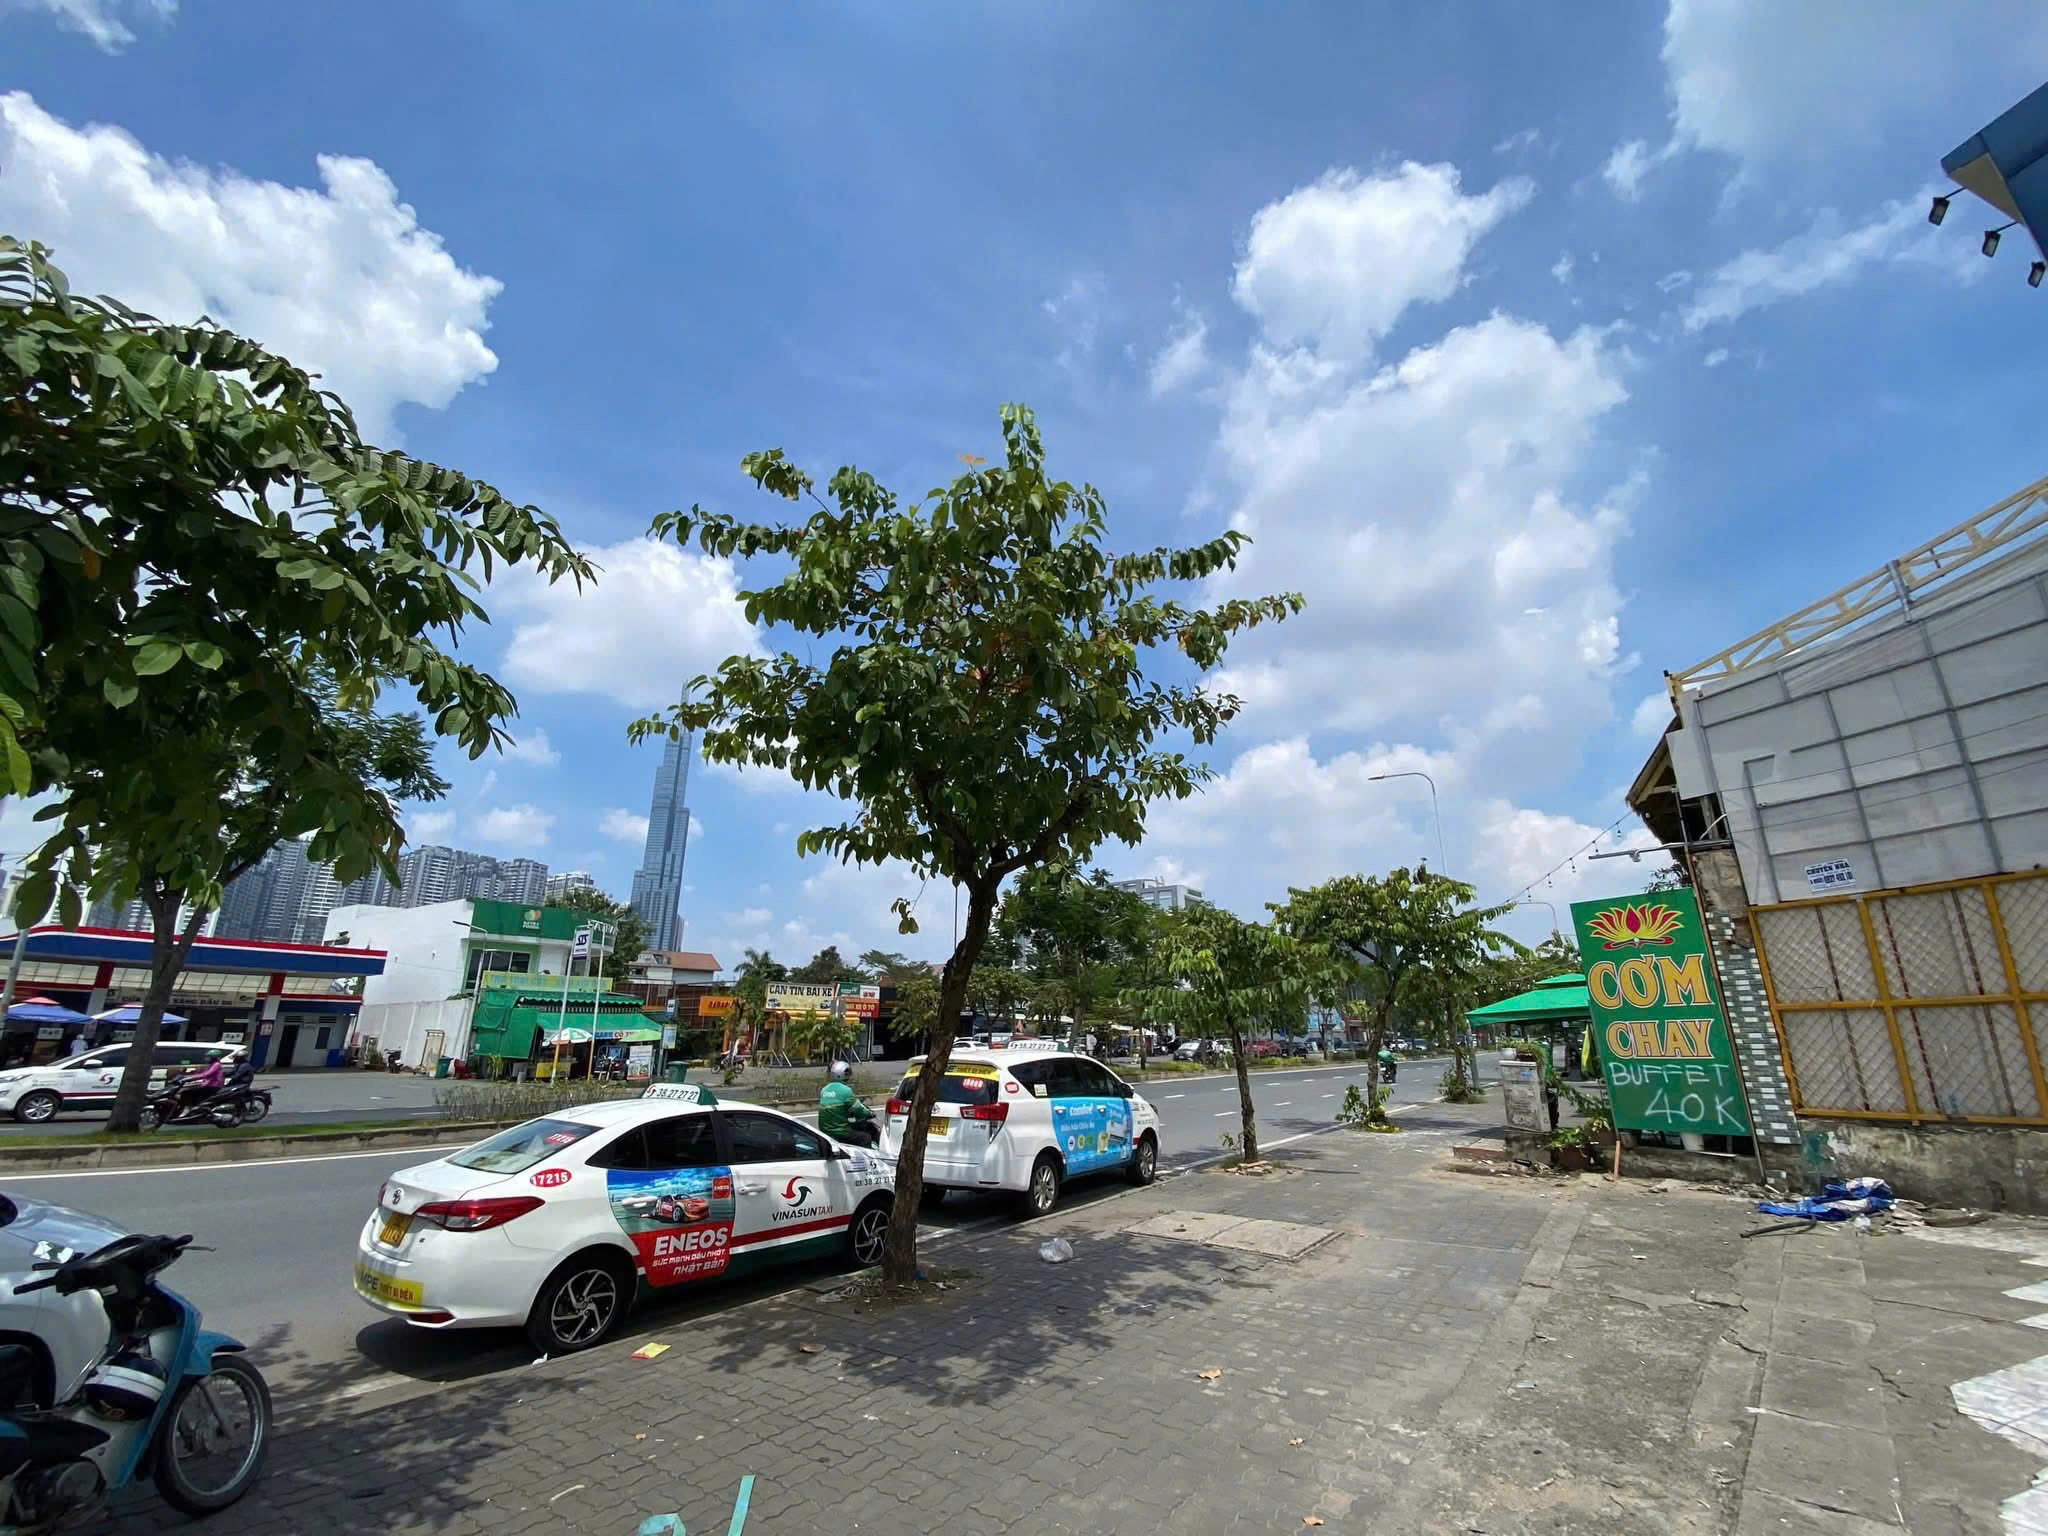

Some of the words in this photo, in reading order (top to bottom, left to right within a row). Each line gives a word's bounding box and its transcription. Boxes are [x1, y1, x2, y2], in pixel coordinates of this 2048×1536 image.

[1587, 953, 1715, 1009] CƠM
[1606, 1019, 1714, 1059] CHAY
[1608, 1062, 1729, 1087] BUFFET
[531, 1171, 568, 1186] 17215
[654, 1227, 729, 1256] ENEOS
